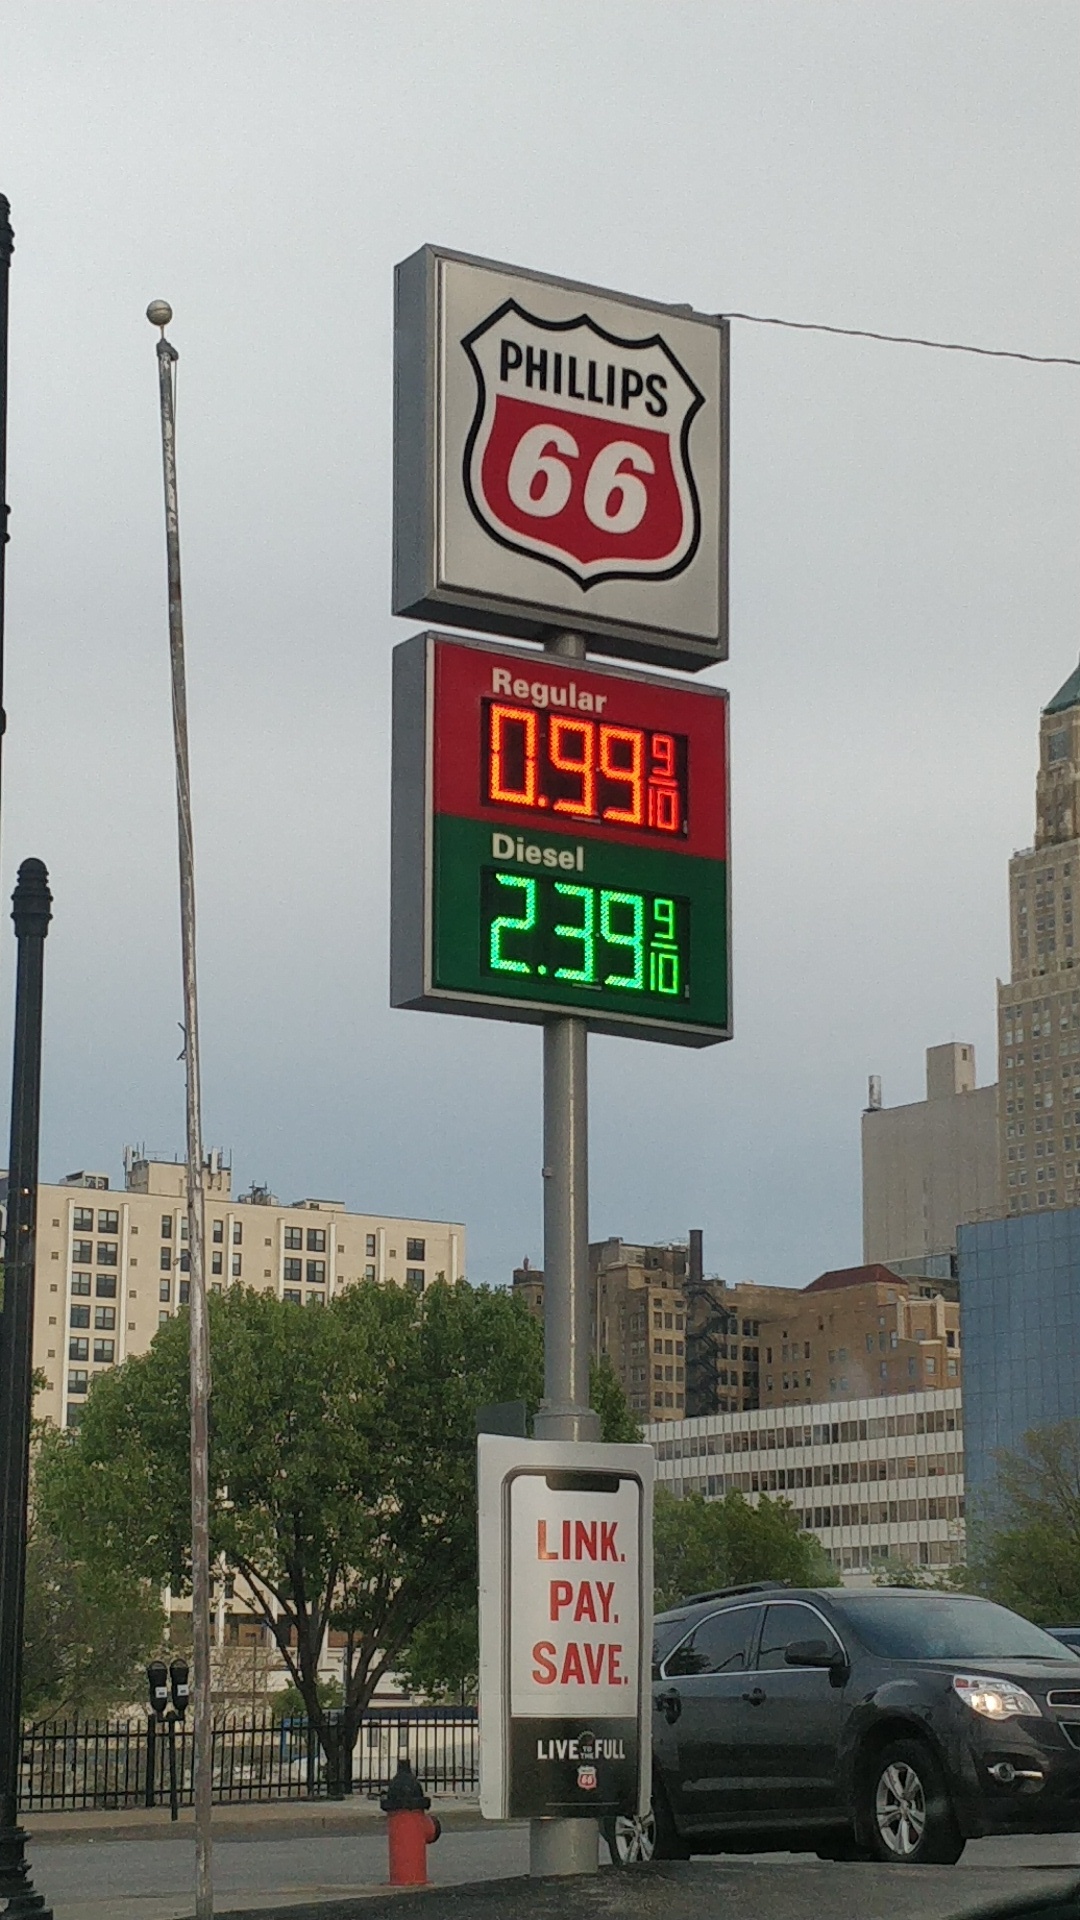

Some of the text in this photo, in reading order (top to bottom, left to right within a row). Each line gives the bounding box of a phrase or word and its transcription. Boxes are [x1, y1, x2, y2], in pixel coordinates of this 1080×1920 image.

[500, 338, 669, 417] PHILLIPS
[507, 423, 656, 534] 66
[491, 667, 607, 713] Regular
[490, 703, 645, 825] 0.99
[492, 832, 584, 872] Diesel
[490, 873, 644, 989] 2.39
[537, 1519, 626, 1562] LINK.
[550, 1580, 619, 1624] PAY.
[532, 1640, 629, 1685] SAVE.
[537, 1739, 580, 1760] LIVE
[595, 1739, 626, 1759] FULL
